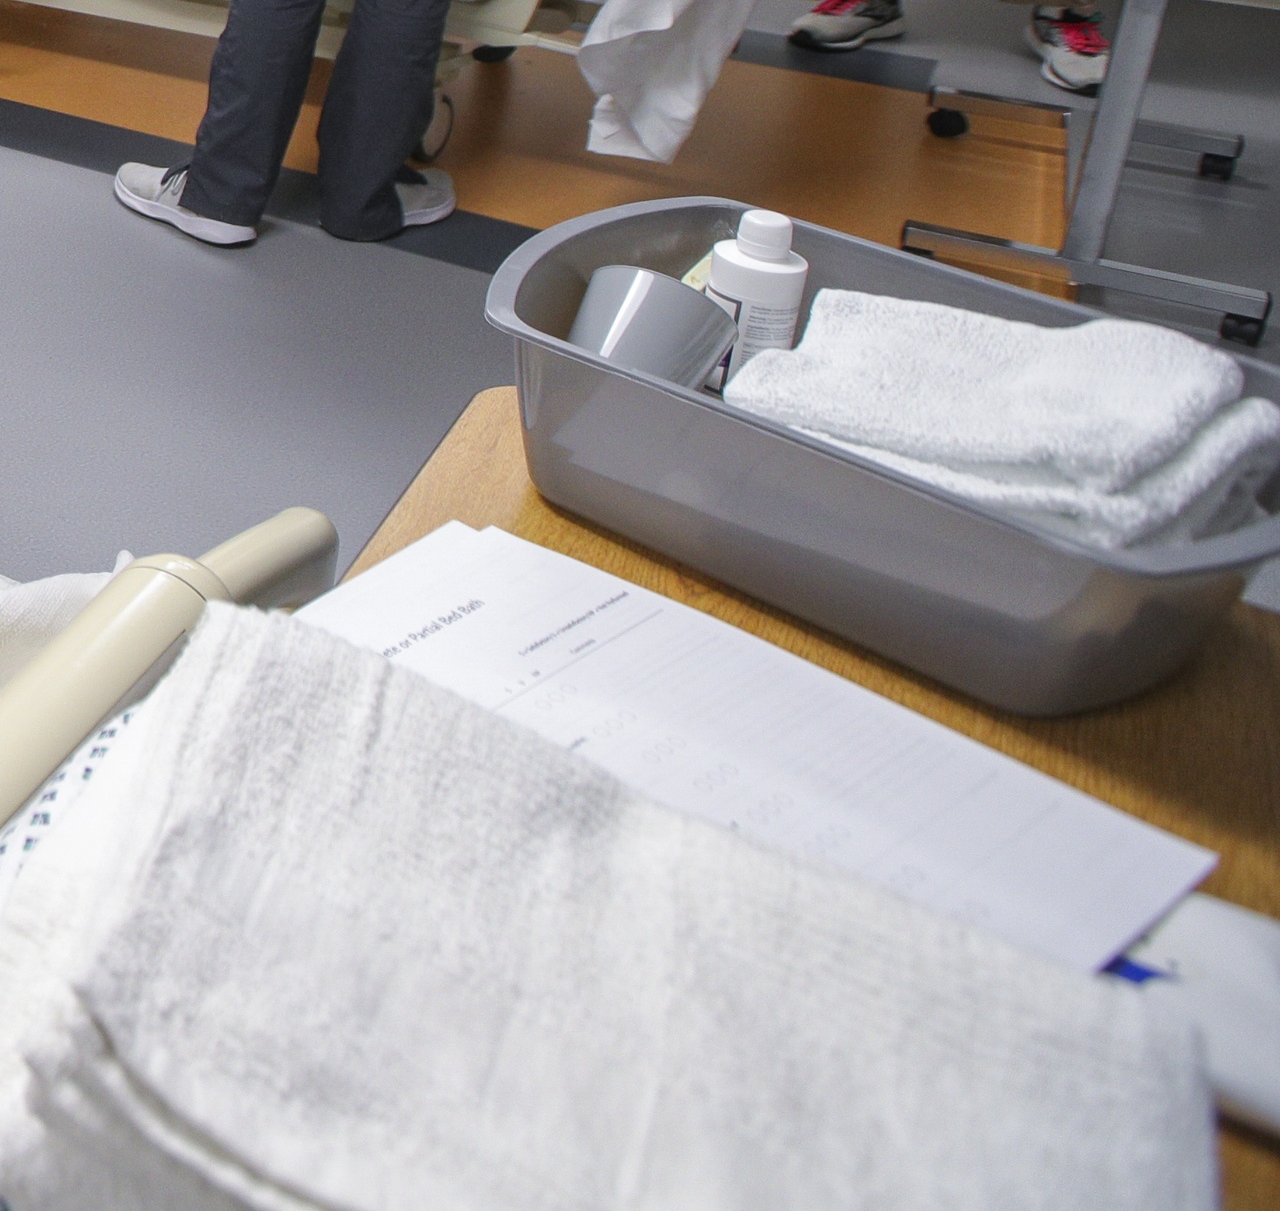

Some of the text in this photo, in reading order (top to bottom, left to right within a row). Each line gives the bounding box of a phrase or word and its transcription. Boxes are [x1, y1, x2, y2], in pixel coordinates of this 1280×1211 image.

[399, 640, 412, 649] or
[408, 621, 444, 642] Partial
[438, 610, 463, 625] Bed
[457, 598, 486, 615] Bath
